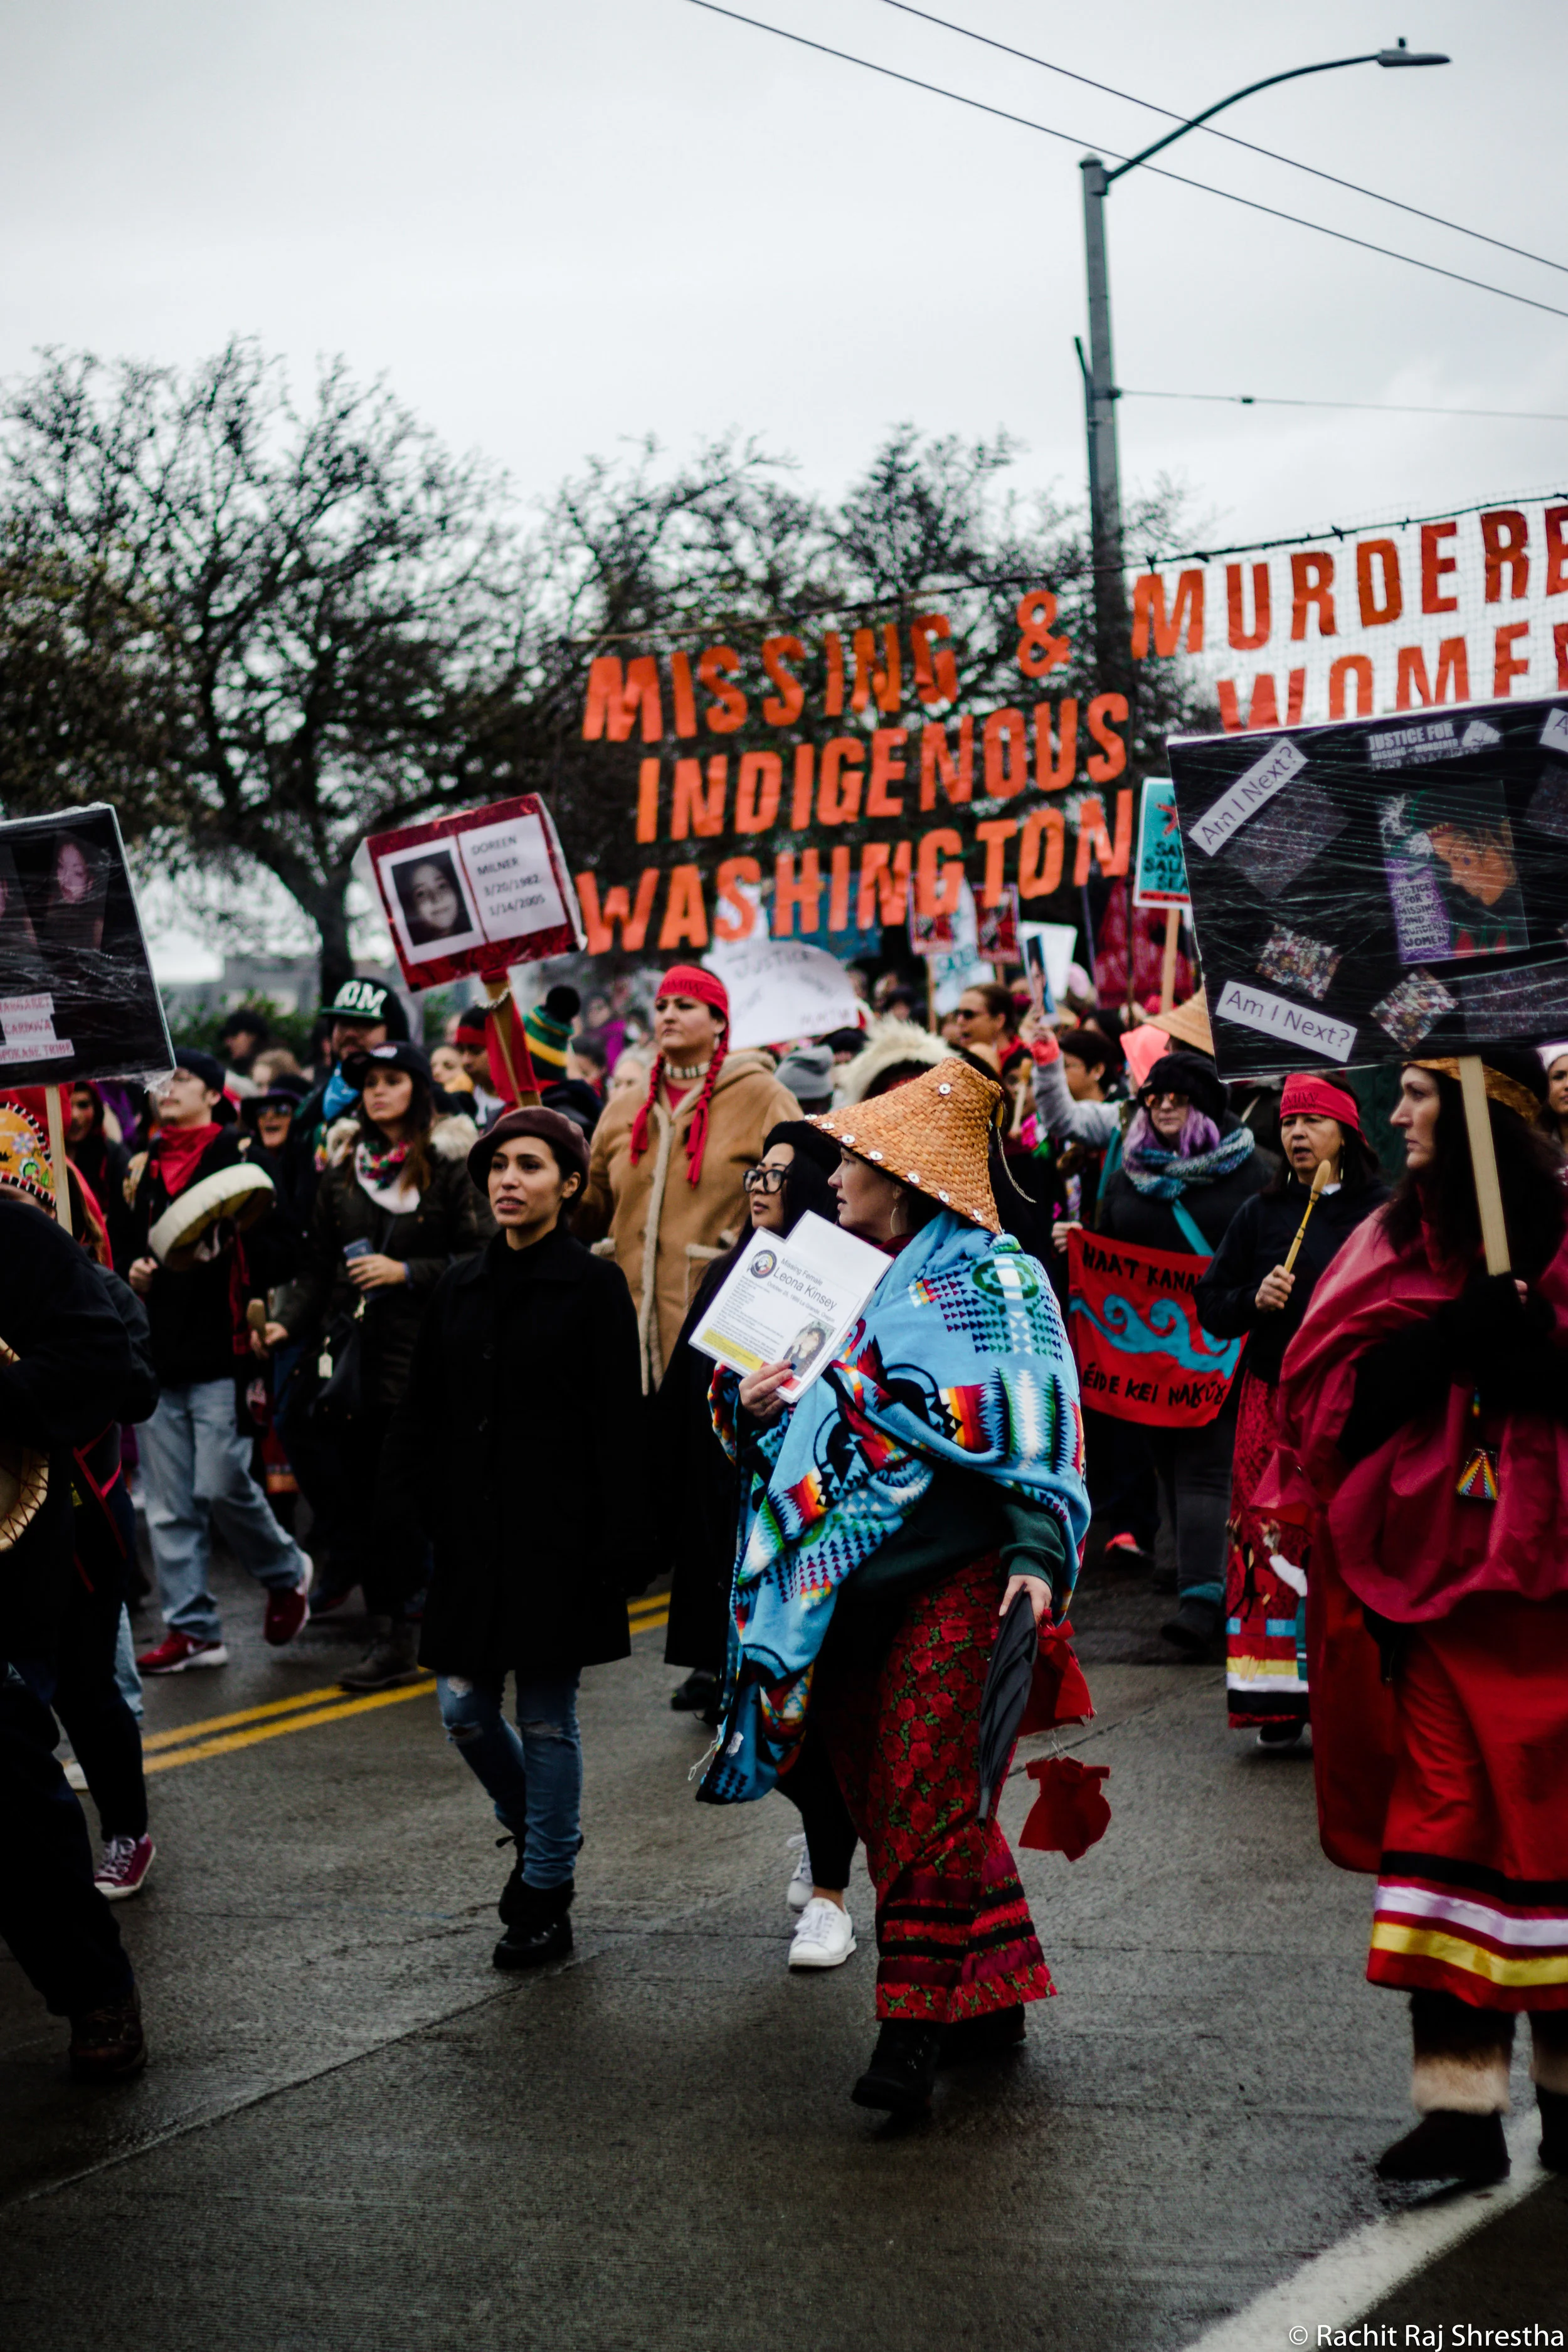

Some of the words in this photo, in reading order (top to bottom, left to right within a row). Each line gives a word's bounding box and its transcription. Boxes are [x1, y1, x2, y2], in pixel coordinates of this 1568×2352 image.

[583, 615, 958, 743] MISSING
[1016, 590, 1071, 678] &
[1369, 726, 1425, 751] JUSTICE
[1427, 723, 1454, 741] FOR
[637, 693, 1128, 843] INDIGENOUS
[1202, 812, 1236, 845] Am
[1231, 798, 1246, 812] I
[1241, 746, 1296, 803] Next?
[472, 835, 517, 856] DOREEN
[477, 857, 519, 876] MILNER
[576, 789, 1133, 956] WASHINGTON
[1394, 882, 1433, 896] JUSTICE
[1405, 894, 1422, 903] FOR
[1397, 903, 1439, 914] MISSING
[1404, 916, 1424, 925] AND
[1403, 935, 1446, 948] WOMEN
[1226, 990, 1264, 1017] Am
[1271, 1005, 1279, 1021] I
[1284, 1010, 1350, 1047] Next?
[781, 1258, 803, 1275] Missing
[803, 1270, 824, 1286] Female
[1083, 1241, 1139, 1280] HAAT
[773, 1267, 804, 1291] Leona
[804, 1285, 837, 1311] Kinsey
[1125, 1378, 1159, 1404] KEI
